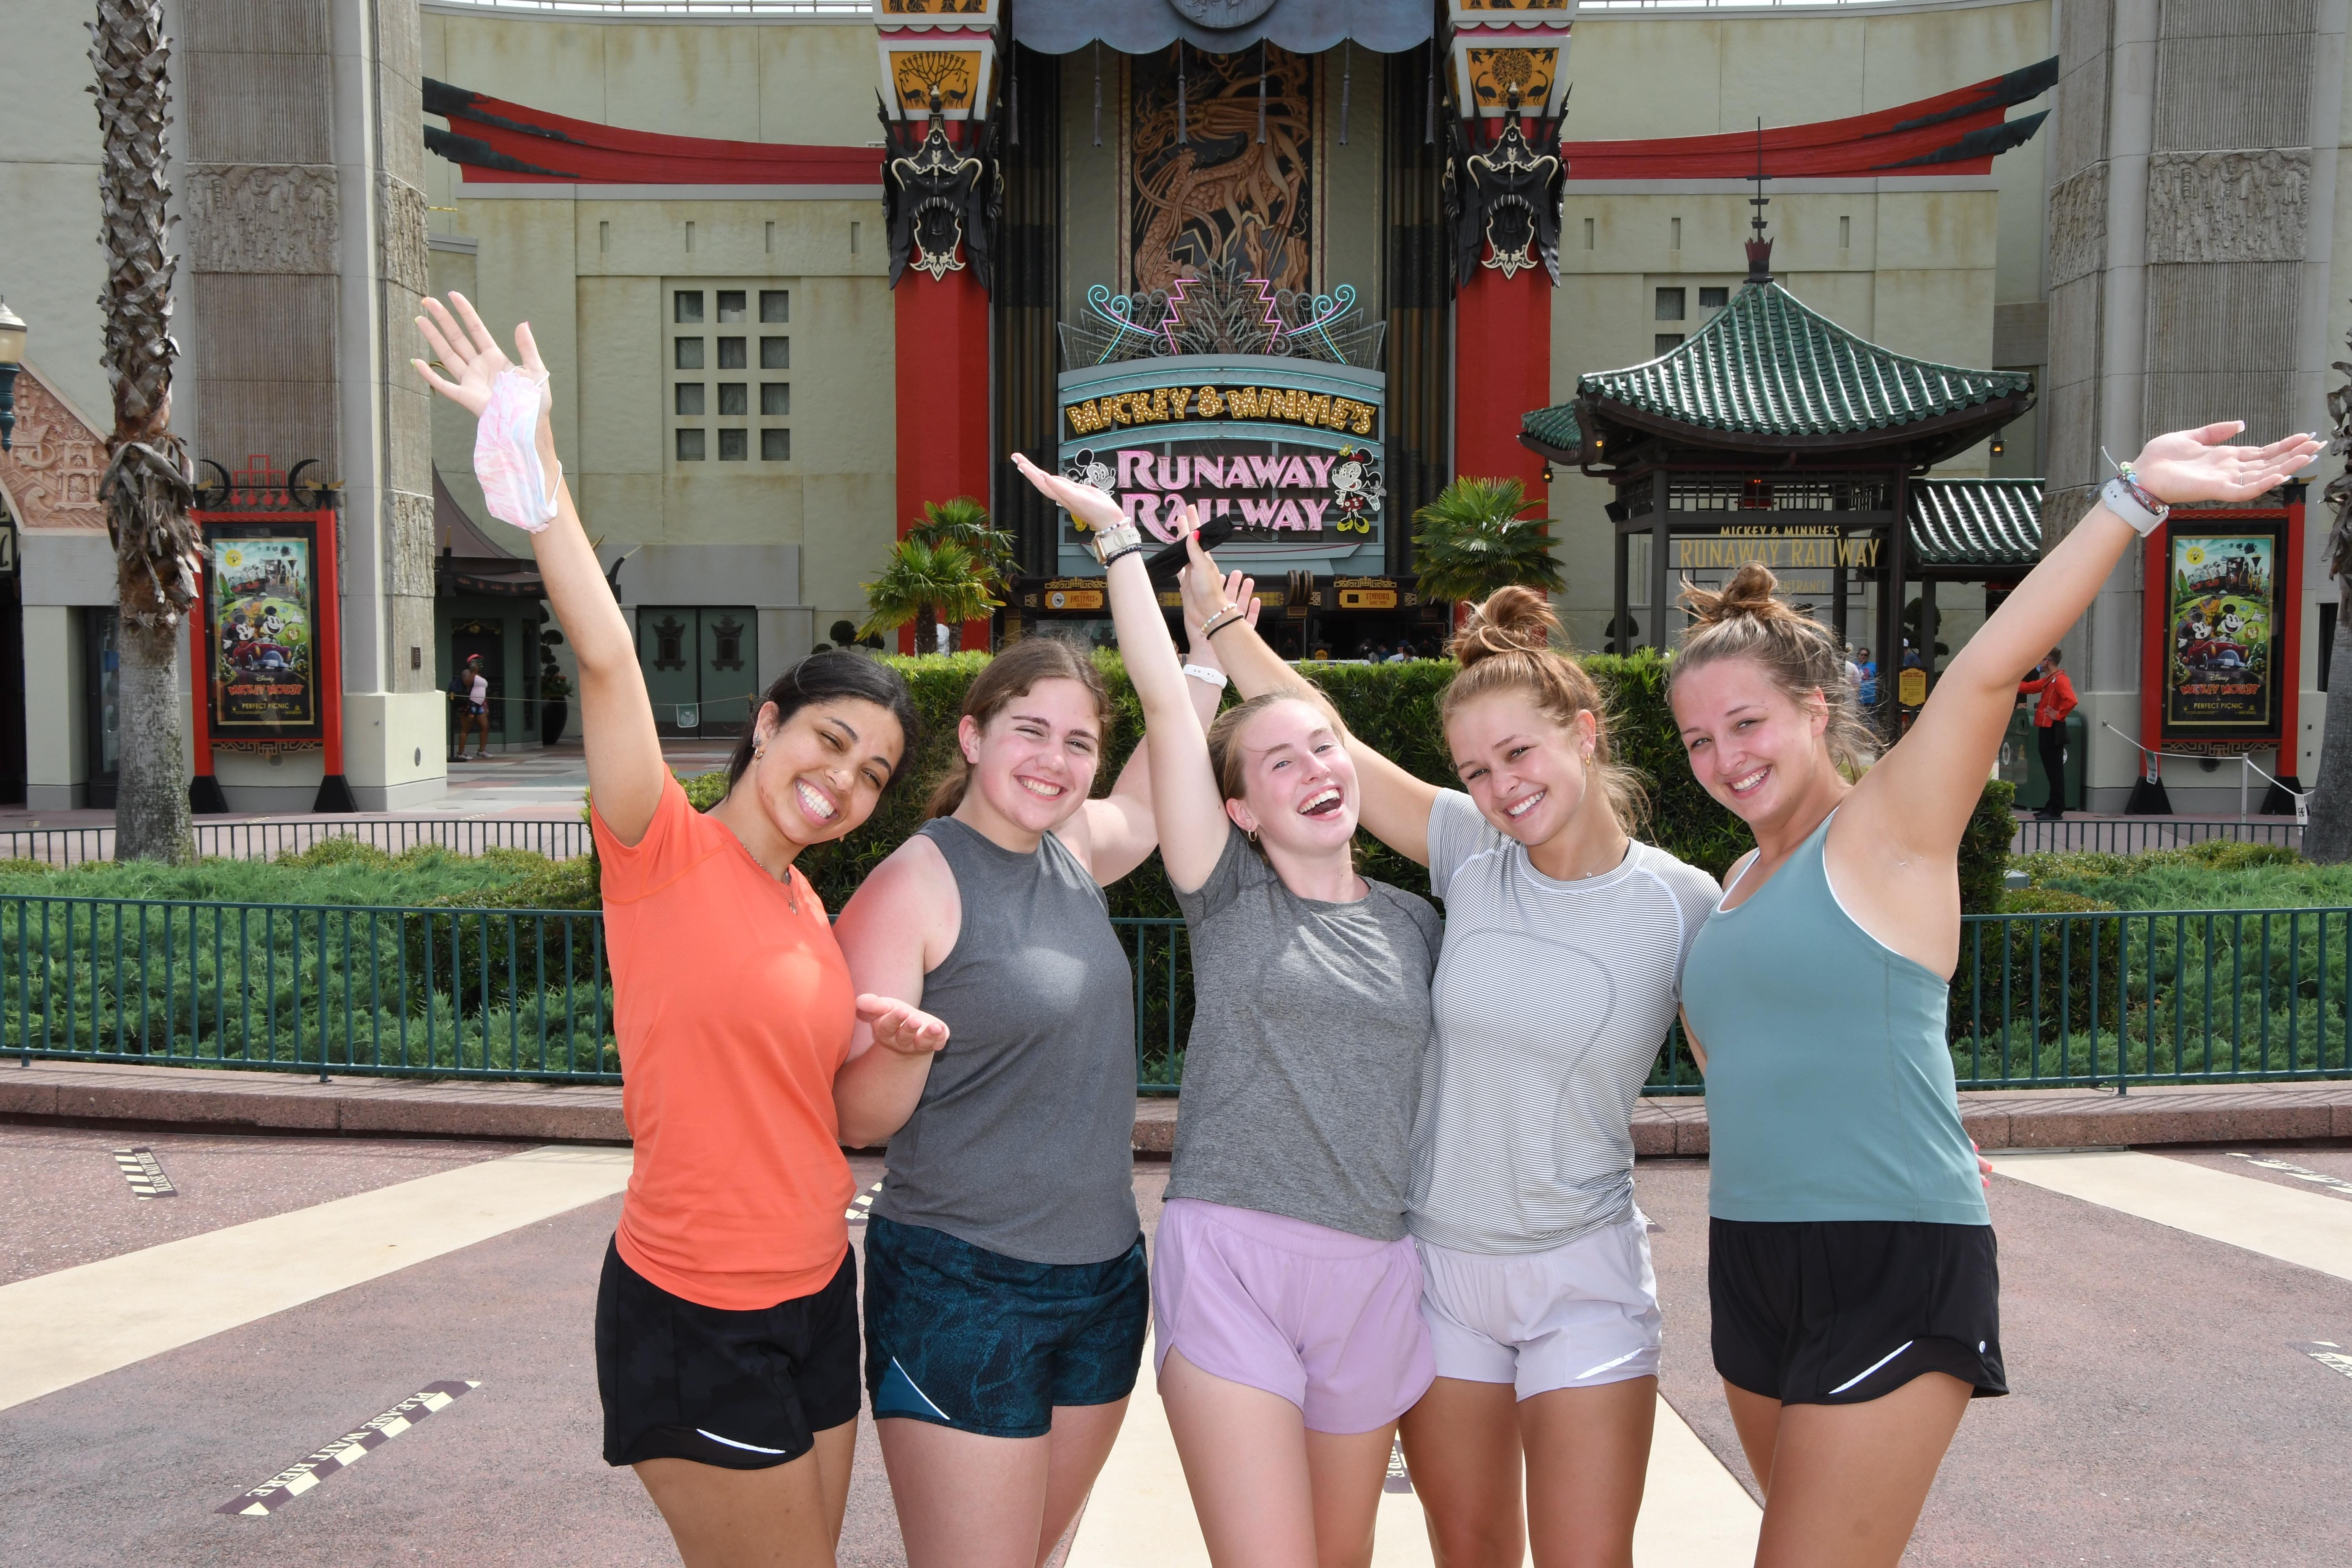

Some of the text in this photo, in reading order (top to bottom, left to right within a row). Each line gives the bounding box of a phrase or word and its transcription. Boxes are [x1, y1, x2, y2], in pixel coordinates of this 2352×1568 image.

[1066, 386, 1376, 434] MICKEY & MINNIE'S
[1116, 450, 1337, 491] RUNAWAY
[1720, 525, 1840, 538] MICKEY & MINNIE'S
[1680, 539, 1880, 568] RUNAWAY RAILWAY
[1779, 580, 1826, 593] ENTRANCE
[1366, 593, 1390, 601] STANDBY
[255, 674, 275, 683] Disney
[2208, 674, 2230, 683] Disney
[227, 684, 304, 695] MICKEY MOUSE
[2180, 683, 2260, 695] MICKEY MOUSE
[135, 1152, 174, 1192] PLEASE WAIT HERE
[245, 1392, 437, 1497] PLEASE WAIT HERE
